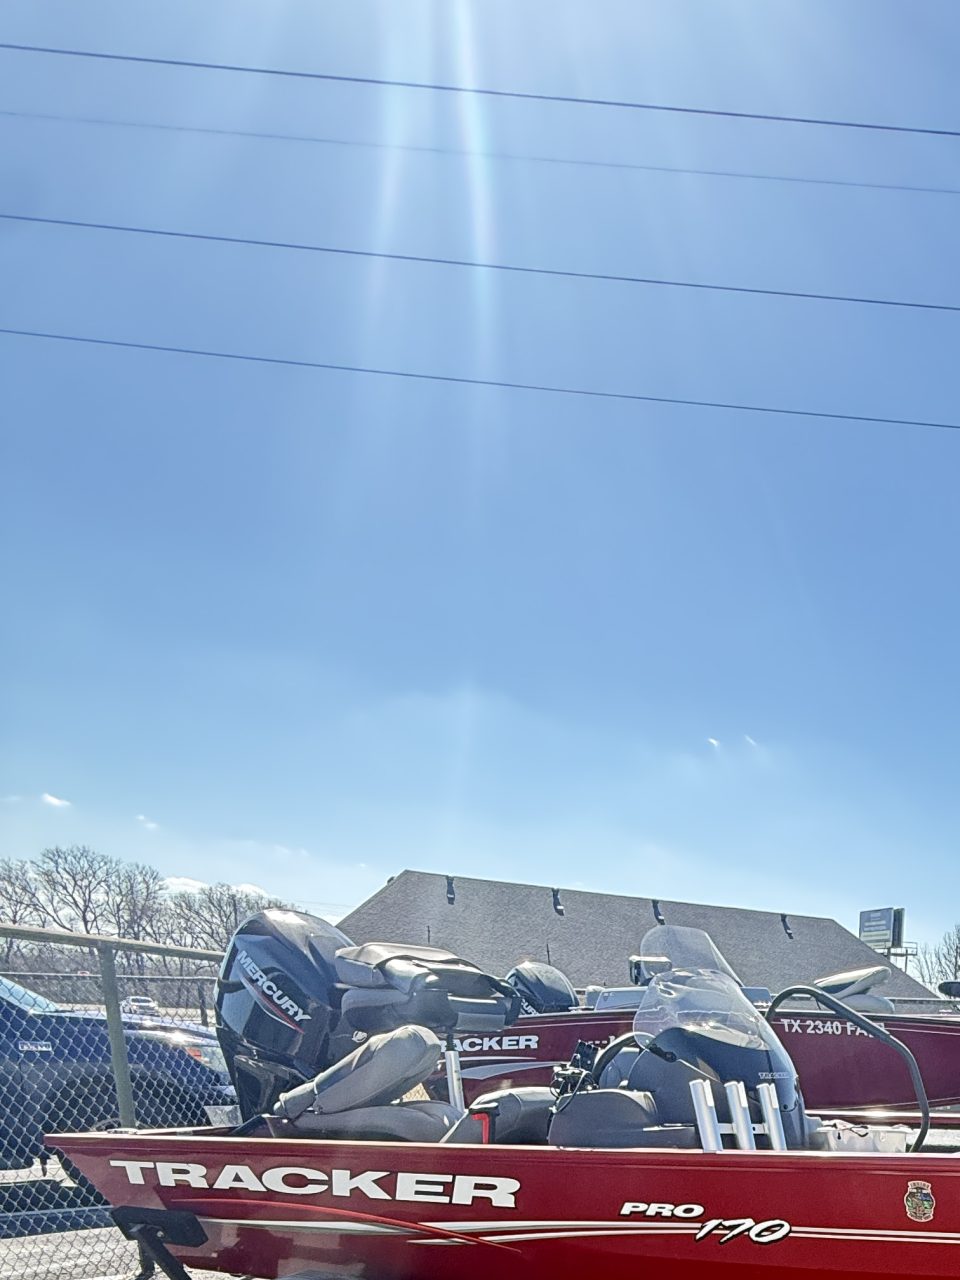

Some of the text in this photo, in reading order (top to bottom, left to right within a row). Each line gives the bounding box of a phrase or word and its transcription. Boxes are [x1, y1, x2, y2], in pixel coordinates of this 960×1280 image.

[238, 950, 312, 1022] MERCURY
[780, 1018, 802, 1033] TX
[806, 1020, 841, 1035] 2340
[440, 1035, 539, 1052] ACKER
[110, 1160, 521, 1208] TRACKER
[620, 1202, 705, 1218] PRO
[695, 1217, 792, 1244] 170
